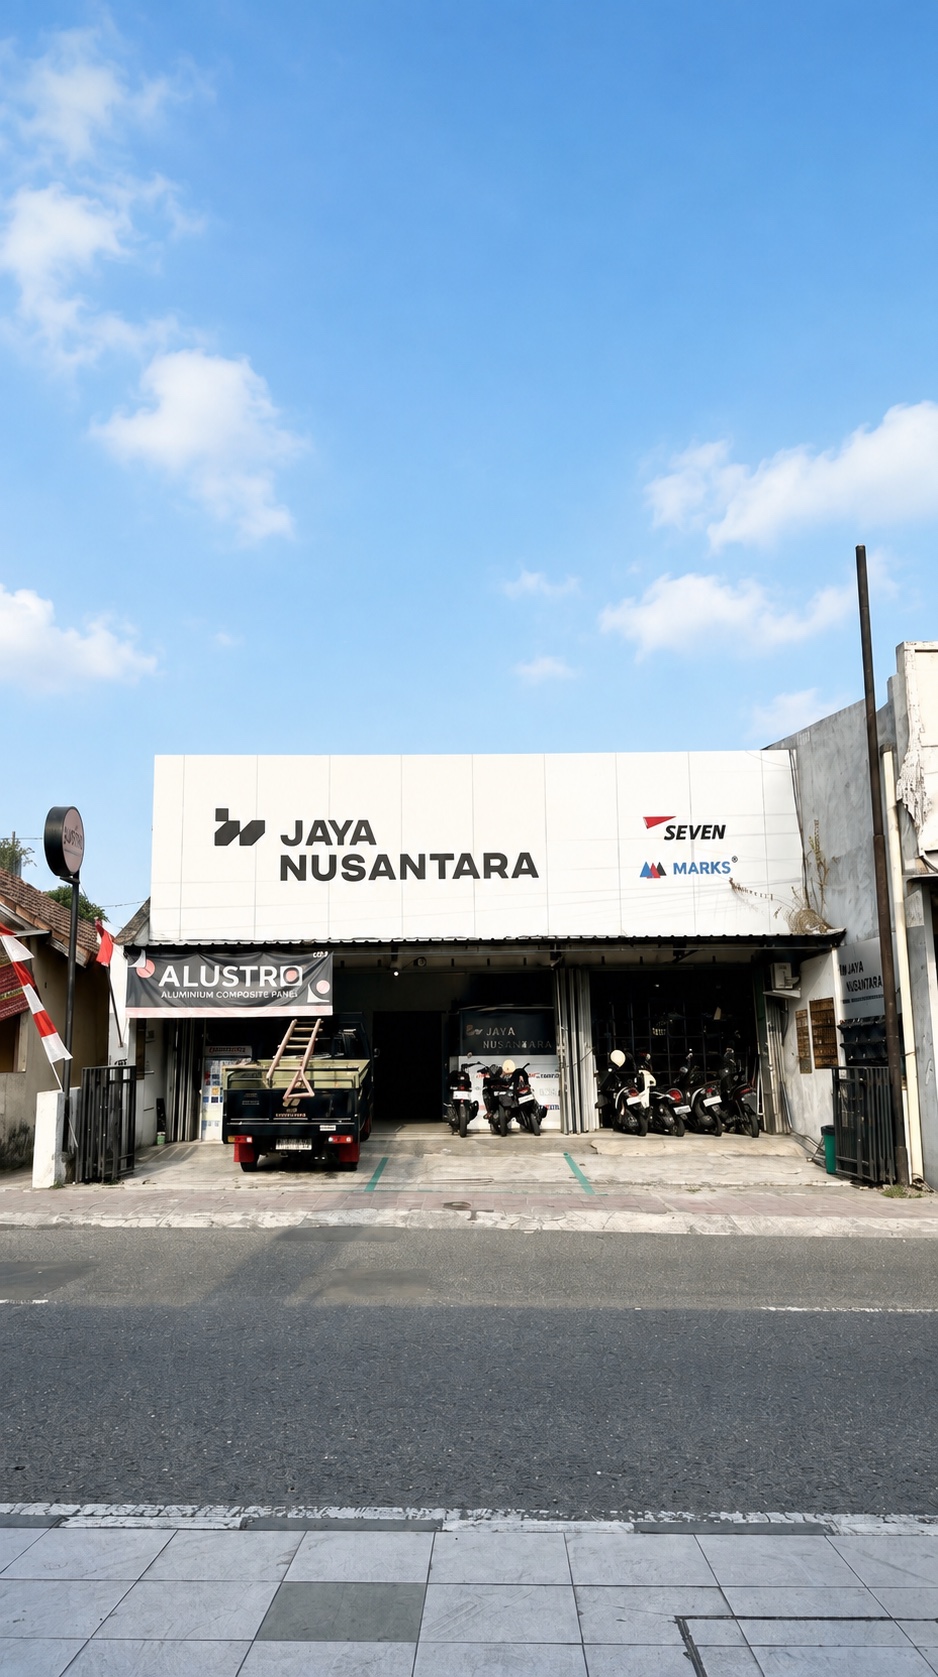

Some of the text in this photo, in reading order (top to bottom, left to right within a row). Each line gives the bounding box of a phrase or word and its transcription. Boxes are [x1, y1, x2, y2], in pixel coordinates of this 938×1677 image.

[280, 819, 377, 847] JAYA
[663, 824, 727, 841] SEVEN
[280, 851, 540, 882] NUSANTARA
[158, 965, 303, 988] ALUSTRO
[847, 960, 864, 976] JAYA
[160, 990, 214, 999] ALUMINIUM
[216, 990, 270, 999] COMPOSITE
[486, 1026, 516, 1037] JAYA
